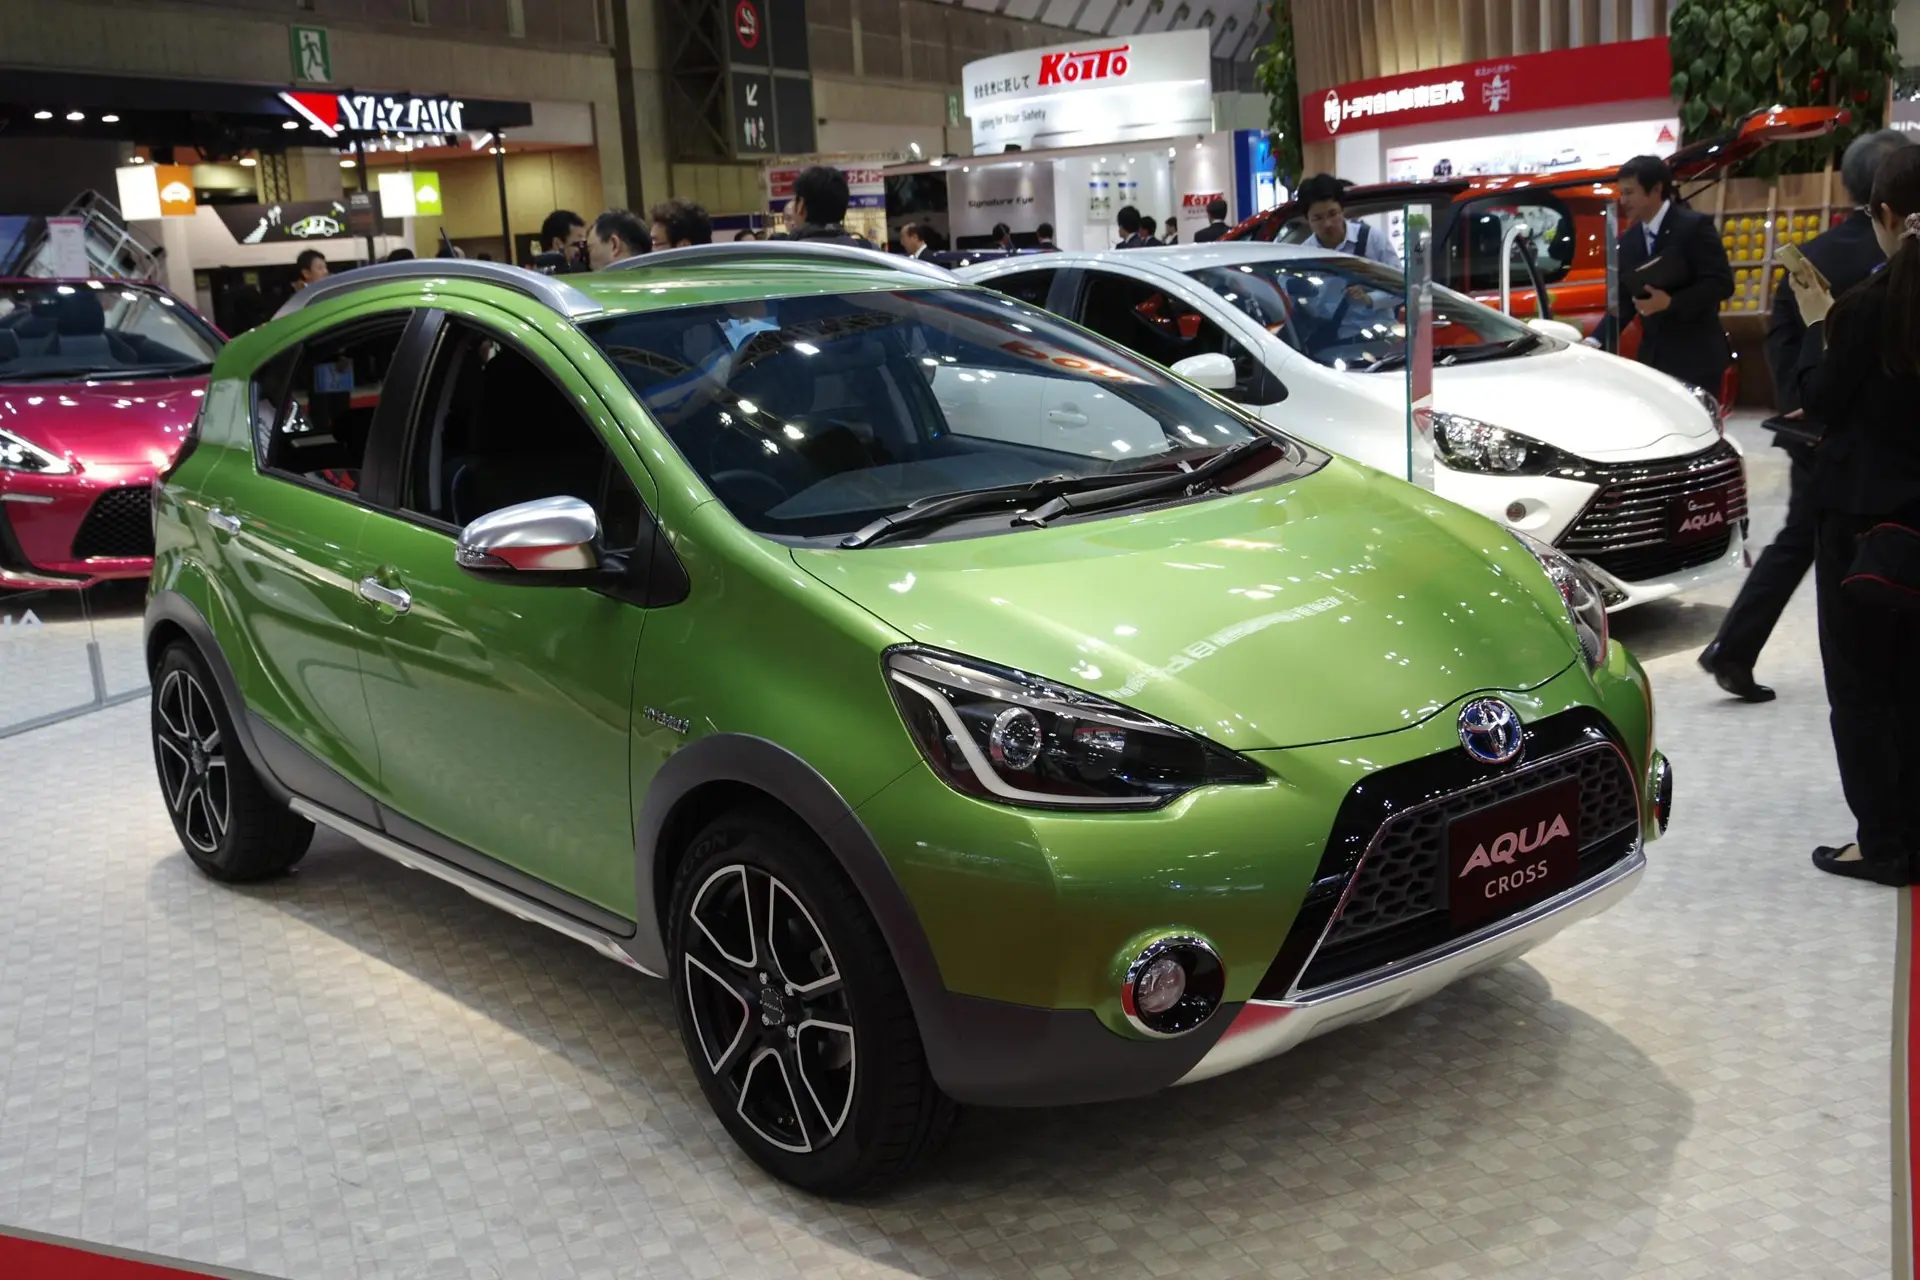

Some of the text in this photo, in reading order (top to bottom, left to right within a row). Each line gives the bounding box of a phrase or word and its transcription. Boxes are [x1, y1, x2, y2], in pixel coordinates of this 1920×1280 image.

[1342, 80, 1464, 119] トヨタ自動車東日本
[1022, 109, 1046, 121] Safety
[968, 198, 1013, 208] Signature
[1679, 511, 1723, 533] AQUA
[1459, 813, 1570, 878] AQUA
[1484, 860, 1548, 898] CROSS
